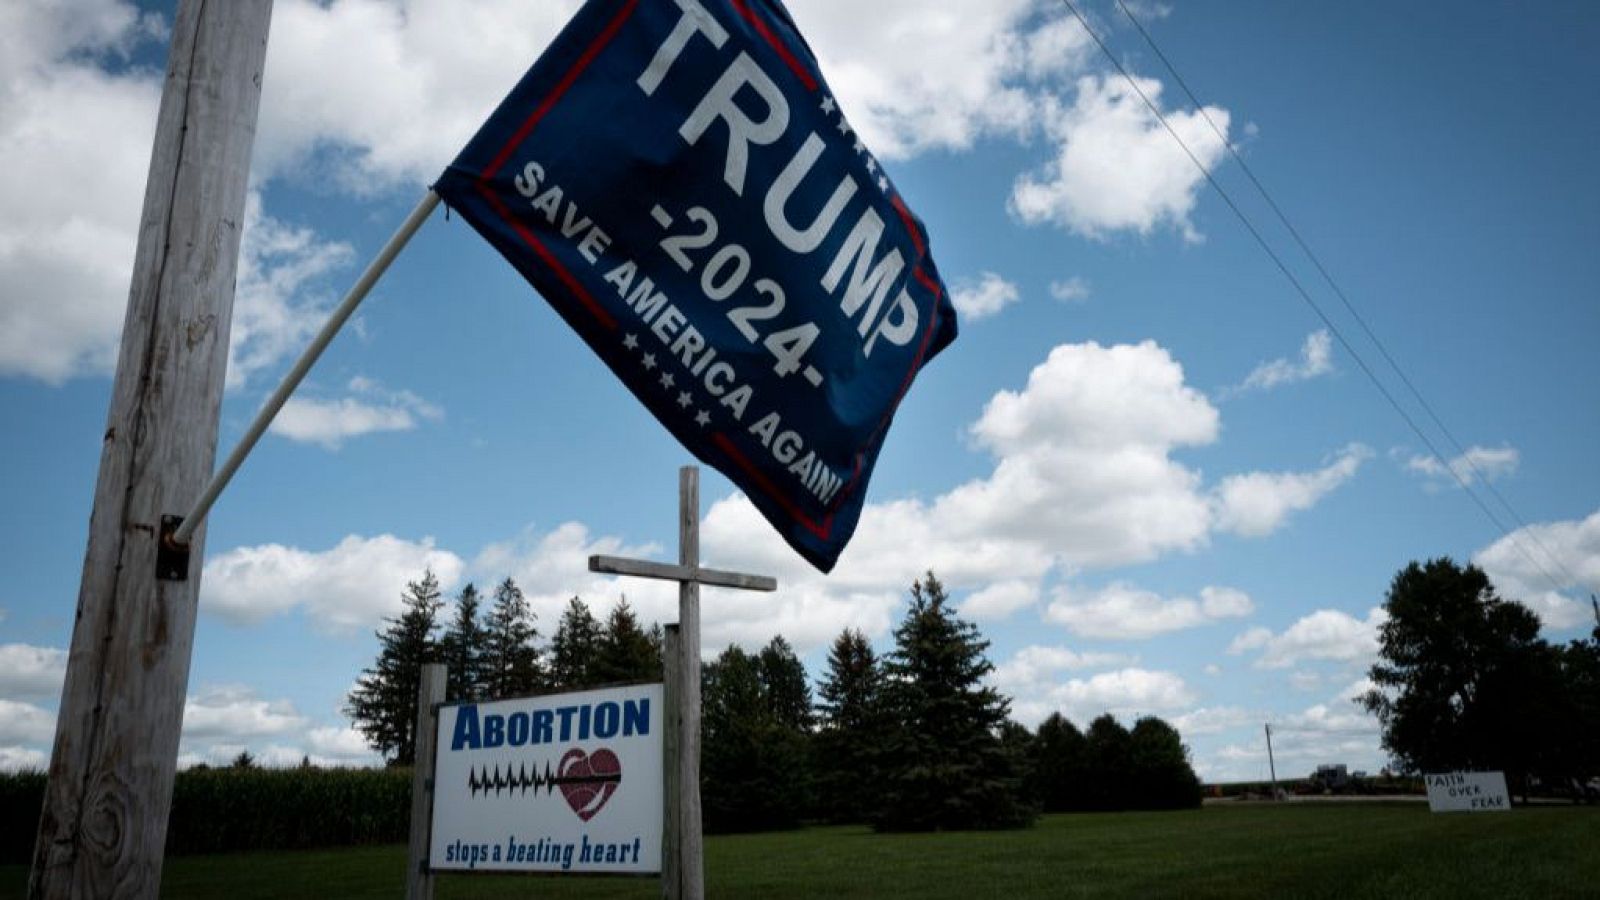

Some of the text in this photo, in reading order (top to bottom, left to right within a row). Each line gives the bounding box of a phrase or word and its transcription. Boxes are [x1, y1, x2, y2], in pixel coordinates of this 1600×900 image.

[636, 0, 919, 358] TRUMP
[514, 161, 845, 507] SAVE AMERICA AGAIN!
[1427, 774, 1465, 787] FAITH
[1448, 784, 1480, 797] OVER
[1471, 795, 1504, 808] FEAR
[446, 835, 641, 869] stops a beating heart
